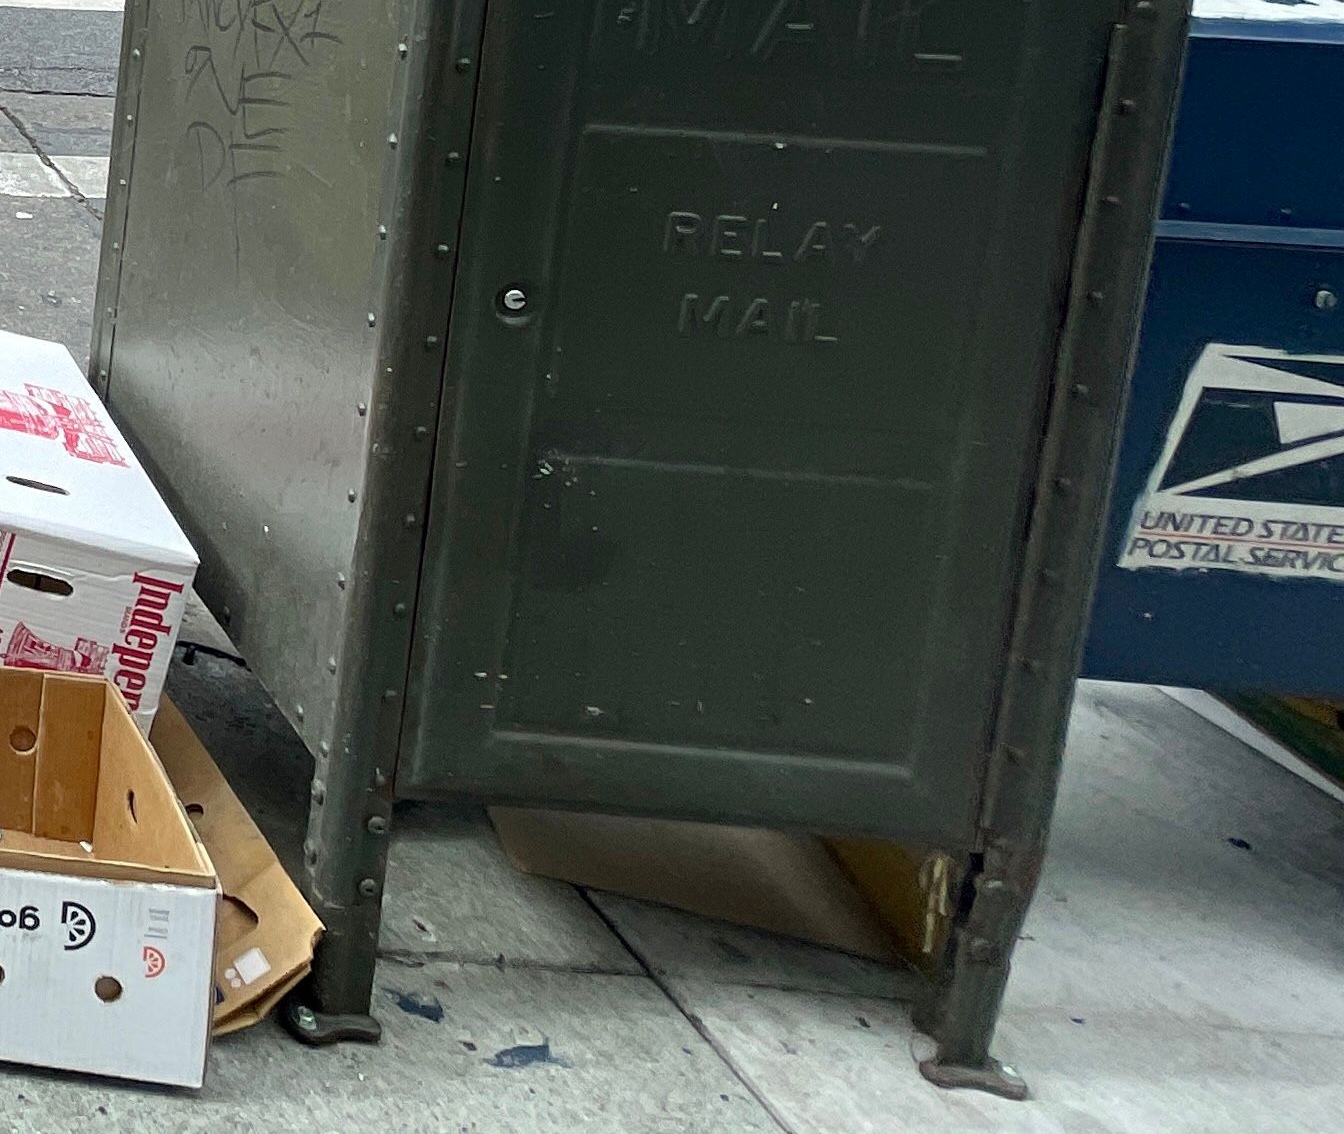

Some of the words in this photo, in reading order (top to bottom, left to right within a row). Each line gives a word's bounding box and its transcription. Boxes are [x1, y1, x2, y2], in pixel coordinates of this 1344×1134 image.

[663, 211, 883, 262] RELAY
[678, 293, 840, 343] MAIL
[1139, 510, 1254, 538] UNITED
[1261, 518, 1344, 545] STATE
[1127, 537, 1240, 564] POSTAL
[1237, 547, 1344, 574] SERVIC
[113, 571, 185, 712] Indepen
